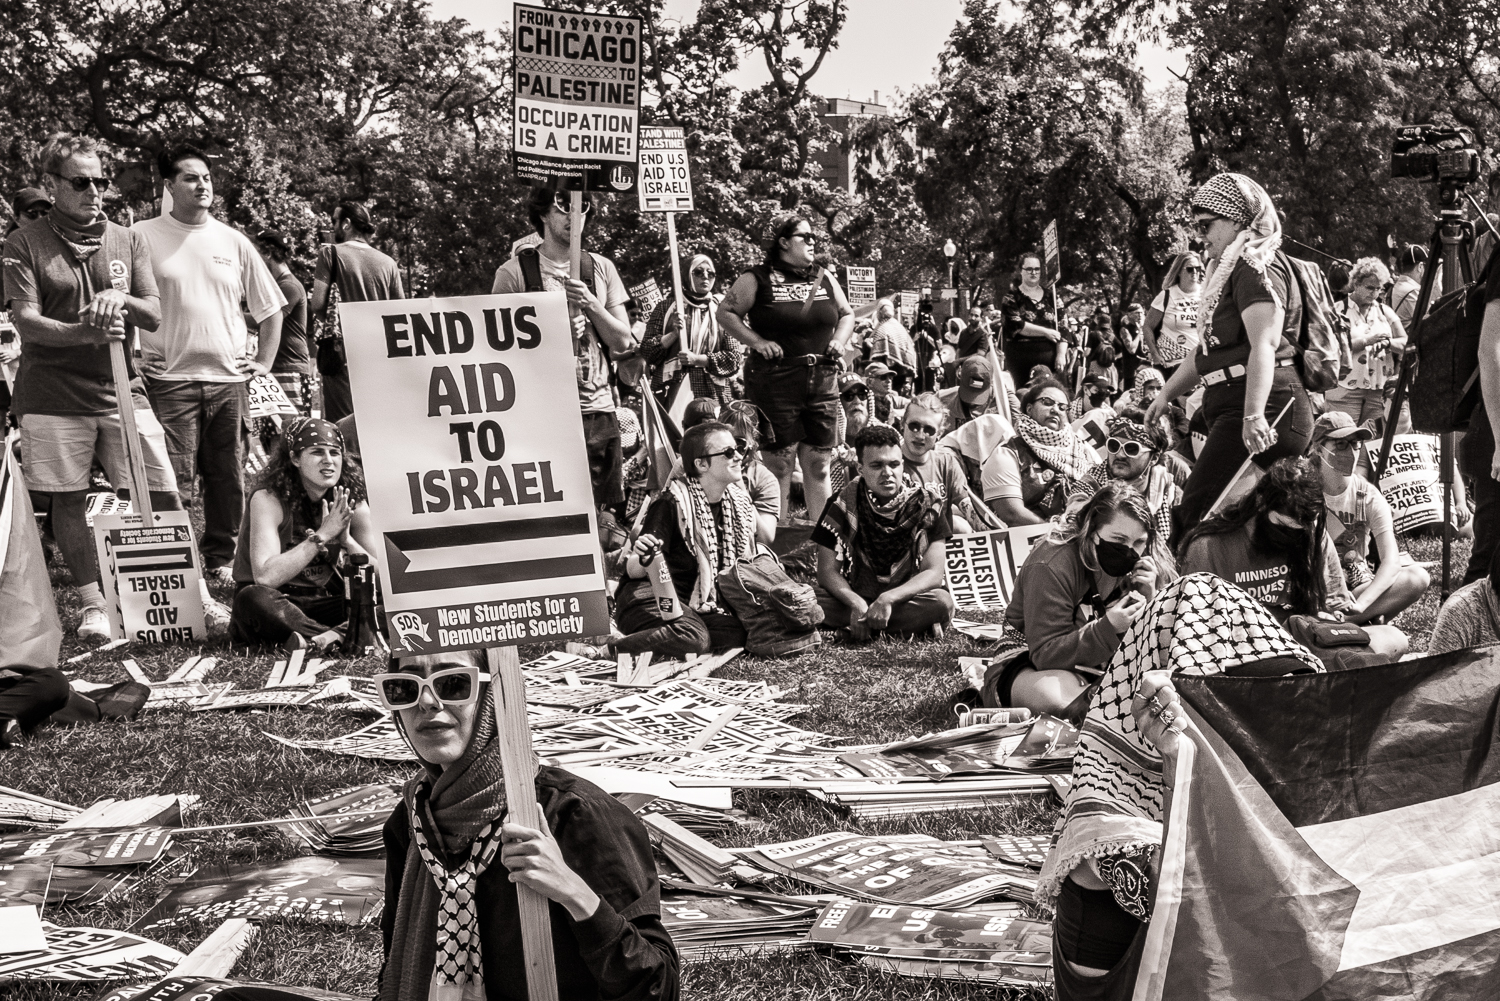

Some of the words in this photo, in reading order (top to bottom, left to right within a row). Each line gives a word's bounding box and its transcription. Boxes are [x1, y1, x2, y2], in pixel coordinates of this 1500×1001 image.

[519, 10, 554, 27] FROM
[518, 26, 636, 64] CHICAGO
[620, 68, 635, 81] TO
[518, 72, 635, 105] PALESTINE
[519, 106, 633, 133] OCCUPATION
[519, 128, 536, 147] IS
[545, 132, 558, 151] A
[568, 134, 631, 155] CRIME!
[517, 157, 539, 167] Chicago
[539, 159, 562, 170] Alliance
[562, 162, 583, 171] Against
[641, 154, 663, 164] END
[667, 154, 684, 164] U.S
[643, 168, 665, 179] AID
[672, 167, 686, 179] TO
[645, 182, 689, 194] ISRAEL!
[381, 310, 474, 358] END
[482, 305, 542, 352] US
[427, 362, 516, 417] AID
[449, 419, 506, 463] TO
[406, 460, 564, 514] ISRAEL
[1385, 485, 1427, 504] STAND
[128, 574, 186, 592] ISRAEL
[149, 592, 170, 607] TO
[145, 607, 178, 626] AID
[437, 607, 473, 626] New
[474, 599, 542, 623] Students
[545, 597, 567, 617] for
[570, 597, 580, 613] a
[398, 616, 420, 631] SDS
[438, 620, 526, 647] Democratic
[529, 615, 584, 637] Society
